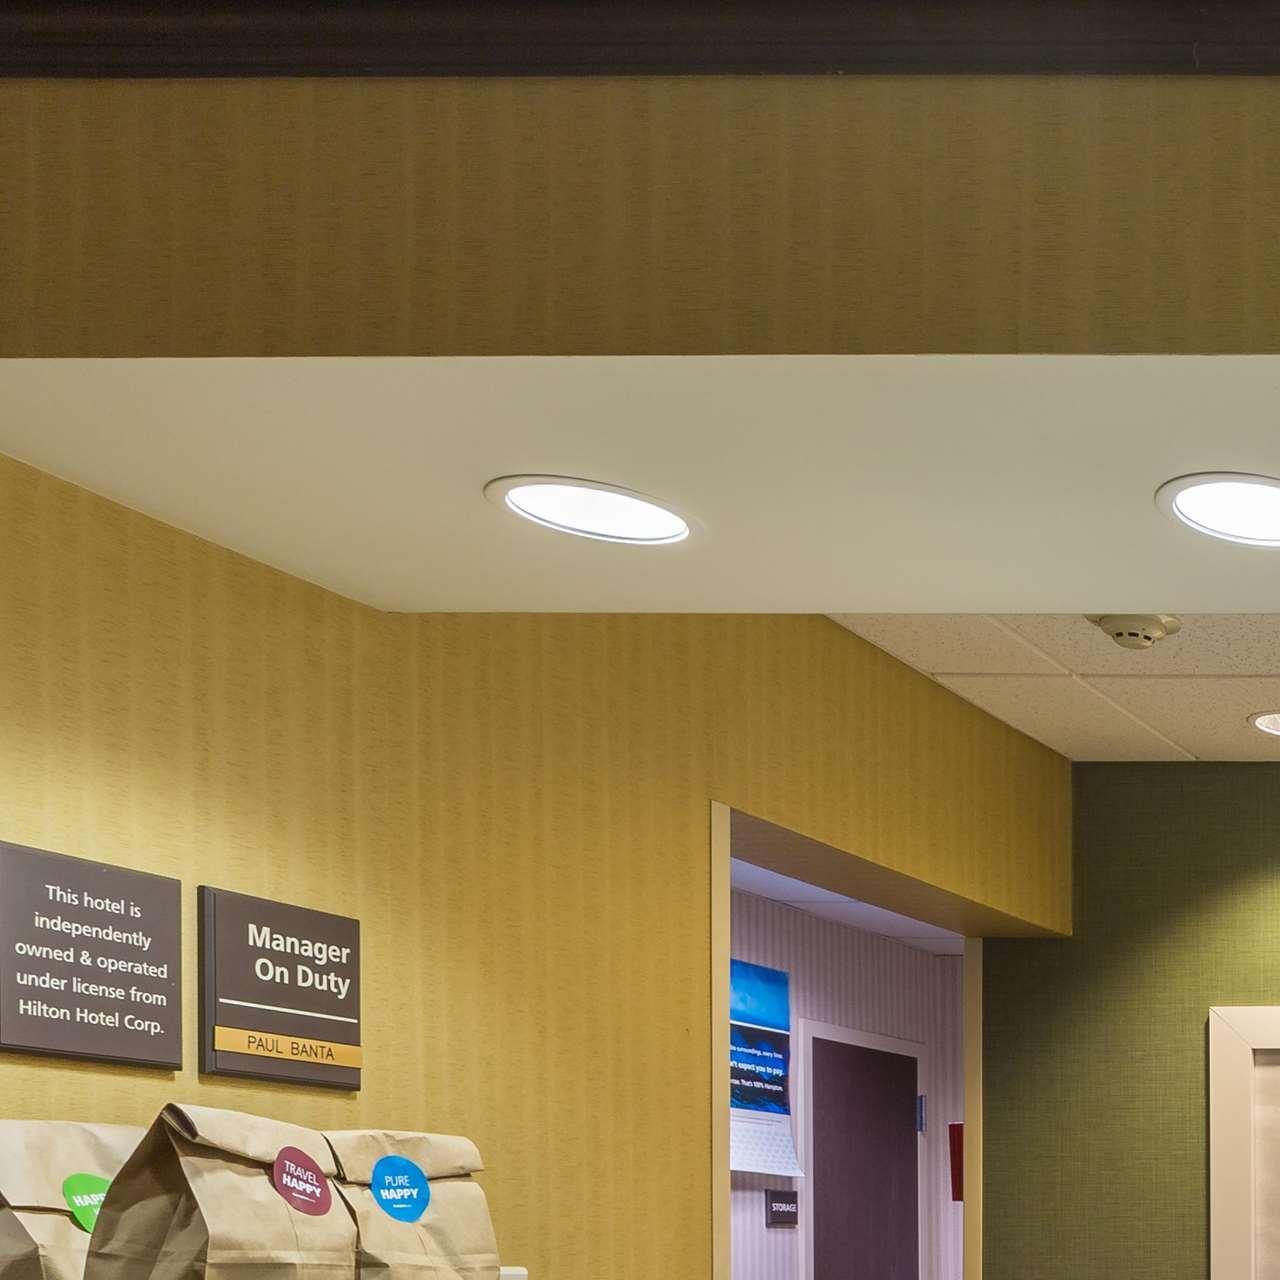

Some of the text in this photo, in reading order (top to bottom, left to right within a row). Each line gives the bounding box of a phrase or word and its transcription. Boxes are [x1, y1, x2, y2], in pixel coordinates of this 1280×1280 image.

[45, 884, 142, 918] This hotel is
[34, 912, 152, 951] independently
[248, 923, 351, 965] Manager
[15, 941, 168, 979] owned & operated
[16, 971, 167, 1007] under license from
[255, 958, 350, 999] On Duty
[19, 999, 165, 1036] Hilton Hotel Corp.
[247, 1035, 335, 1061] PAUL BANTA
[282, 1173, 321, 1198] HAPPY
[284, 1160, 320, 1186] TRAVEL
[385, 1175, 410, 1187] PURE
[72, 1193, 106, 1207] HAPP
[380, 1188, 418, 1200] HAPPY
[772, 1203, 797, 1212] STORAGE
